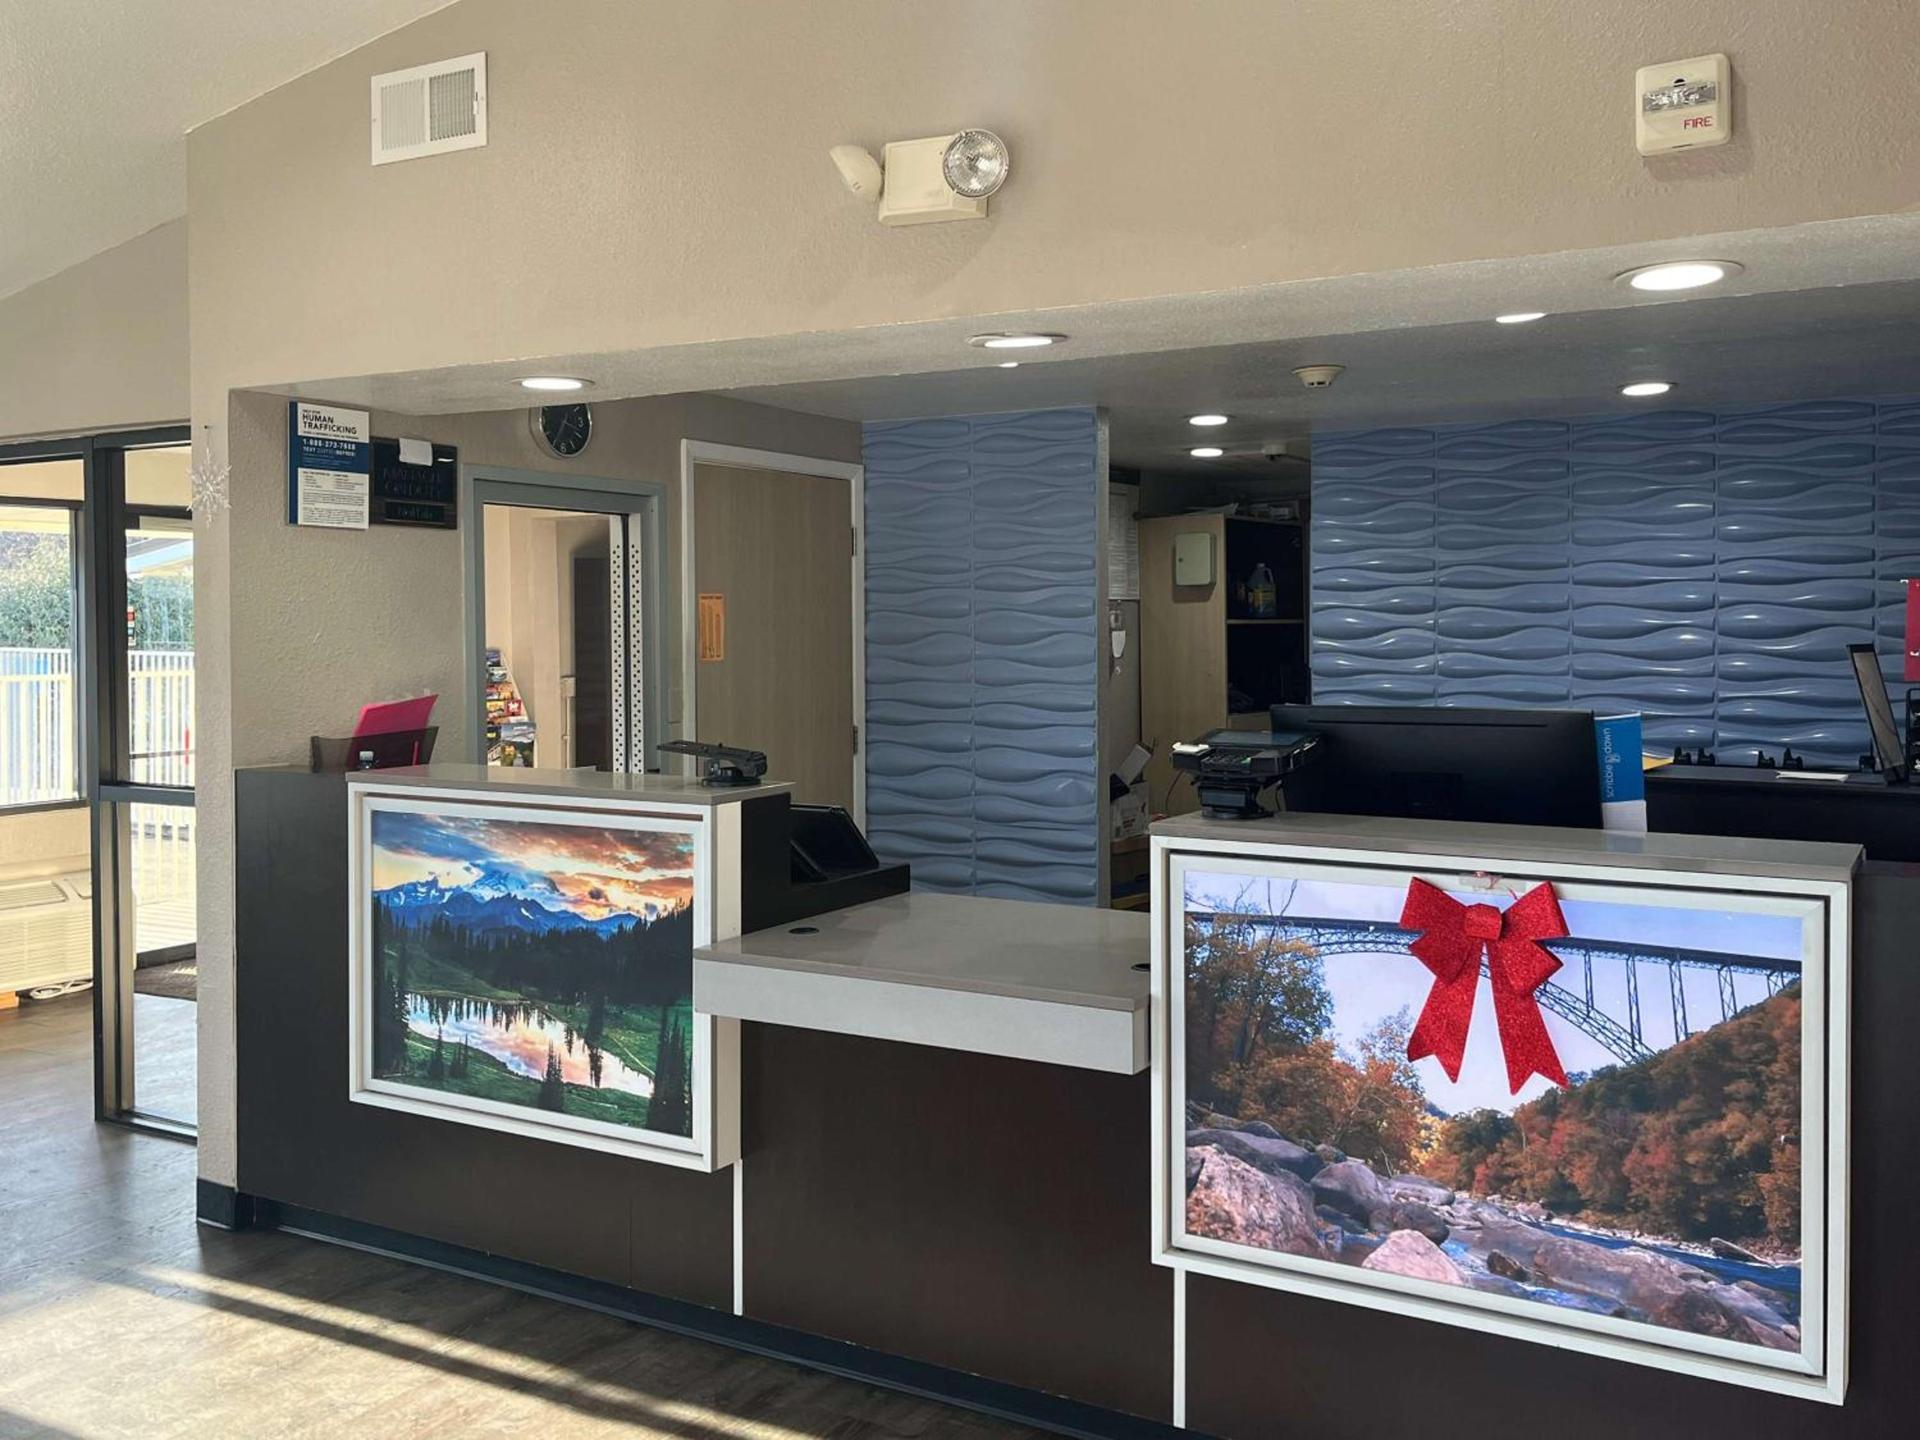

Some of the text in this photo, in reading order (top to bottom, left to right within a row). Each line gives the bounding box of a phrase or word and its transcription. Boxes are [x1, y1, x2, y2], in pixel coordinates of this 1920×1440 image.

[1683, 116, 1713, 130] FIRE
[302, 413, 334, 424] HUMAN
[303, 421, 358, 435] TRAFFICKING
[1601, 727, 1612, 754] down
